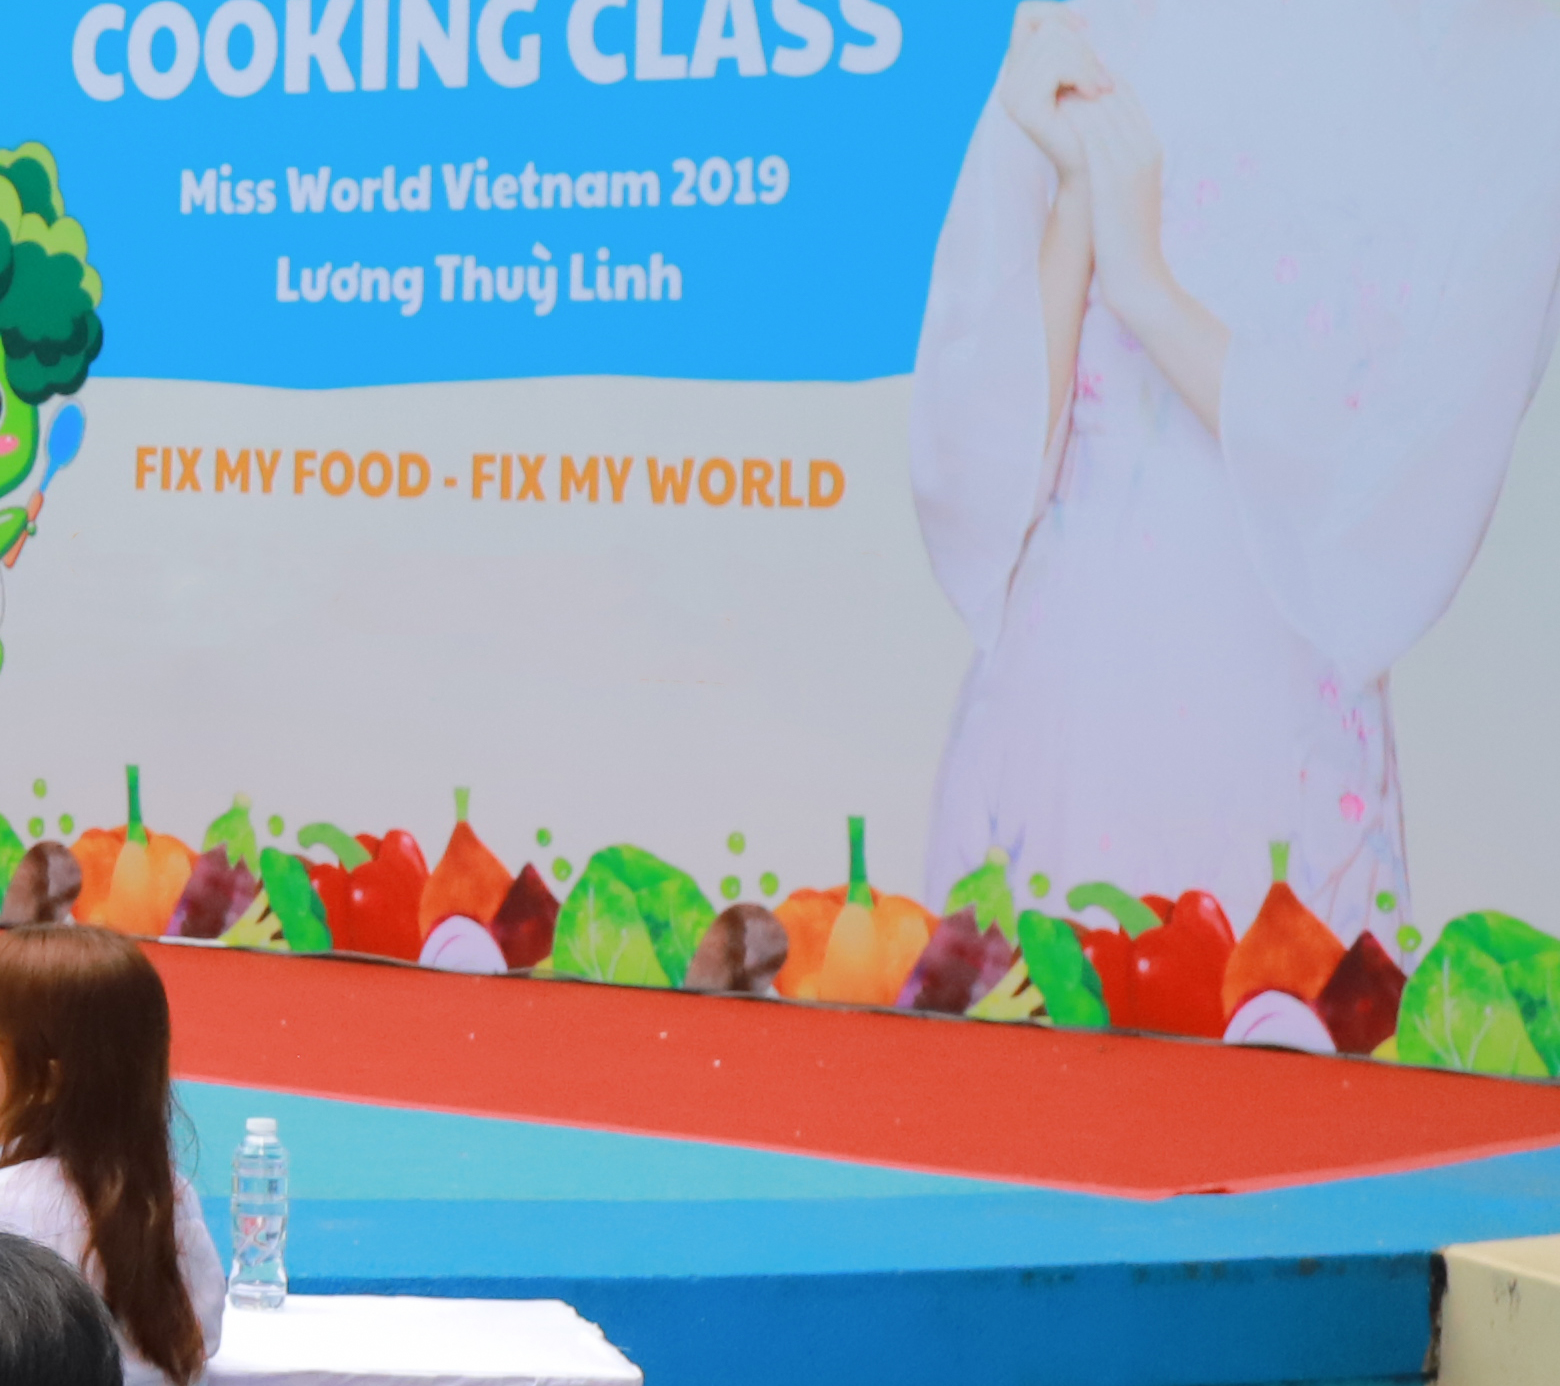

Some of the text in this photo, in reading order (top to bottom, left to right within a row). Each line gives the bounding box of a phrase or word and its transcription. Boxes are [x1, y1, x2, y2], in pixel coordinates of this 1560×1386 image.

[179, 154, 790, 215] Miss World Vietnam 2019
[275, 240, 683, 317] Lương Thuỳ Linh
[134, 445, 202, 493] FIX
[214, 448, 283, 495] MY
[292, 450, 432, 499] FOOD
[471, 453, 547, 502] FIX
[559, 455, 635, 505] MY
[646, 456, 846, 509] WORLD
